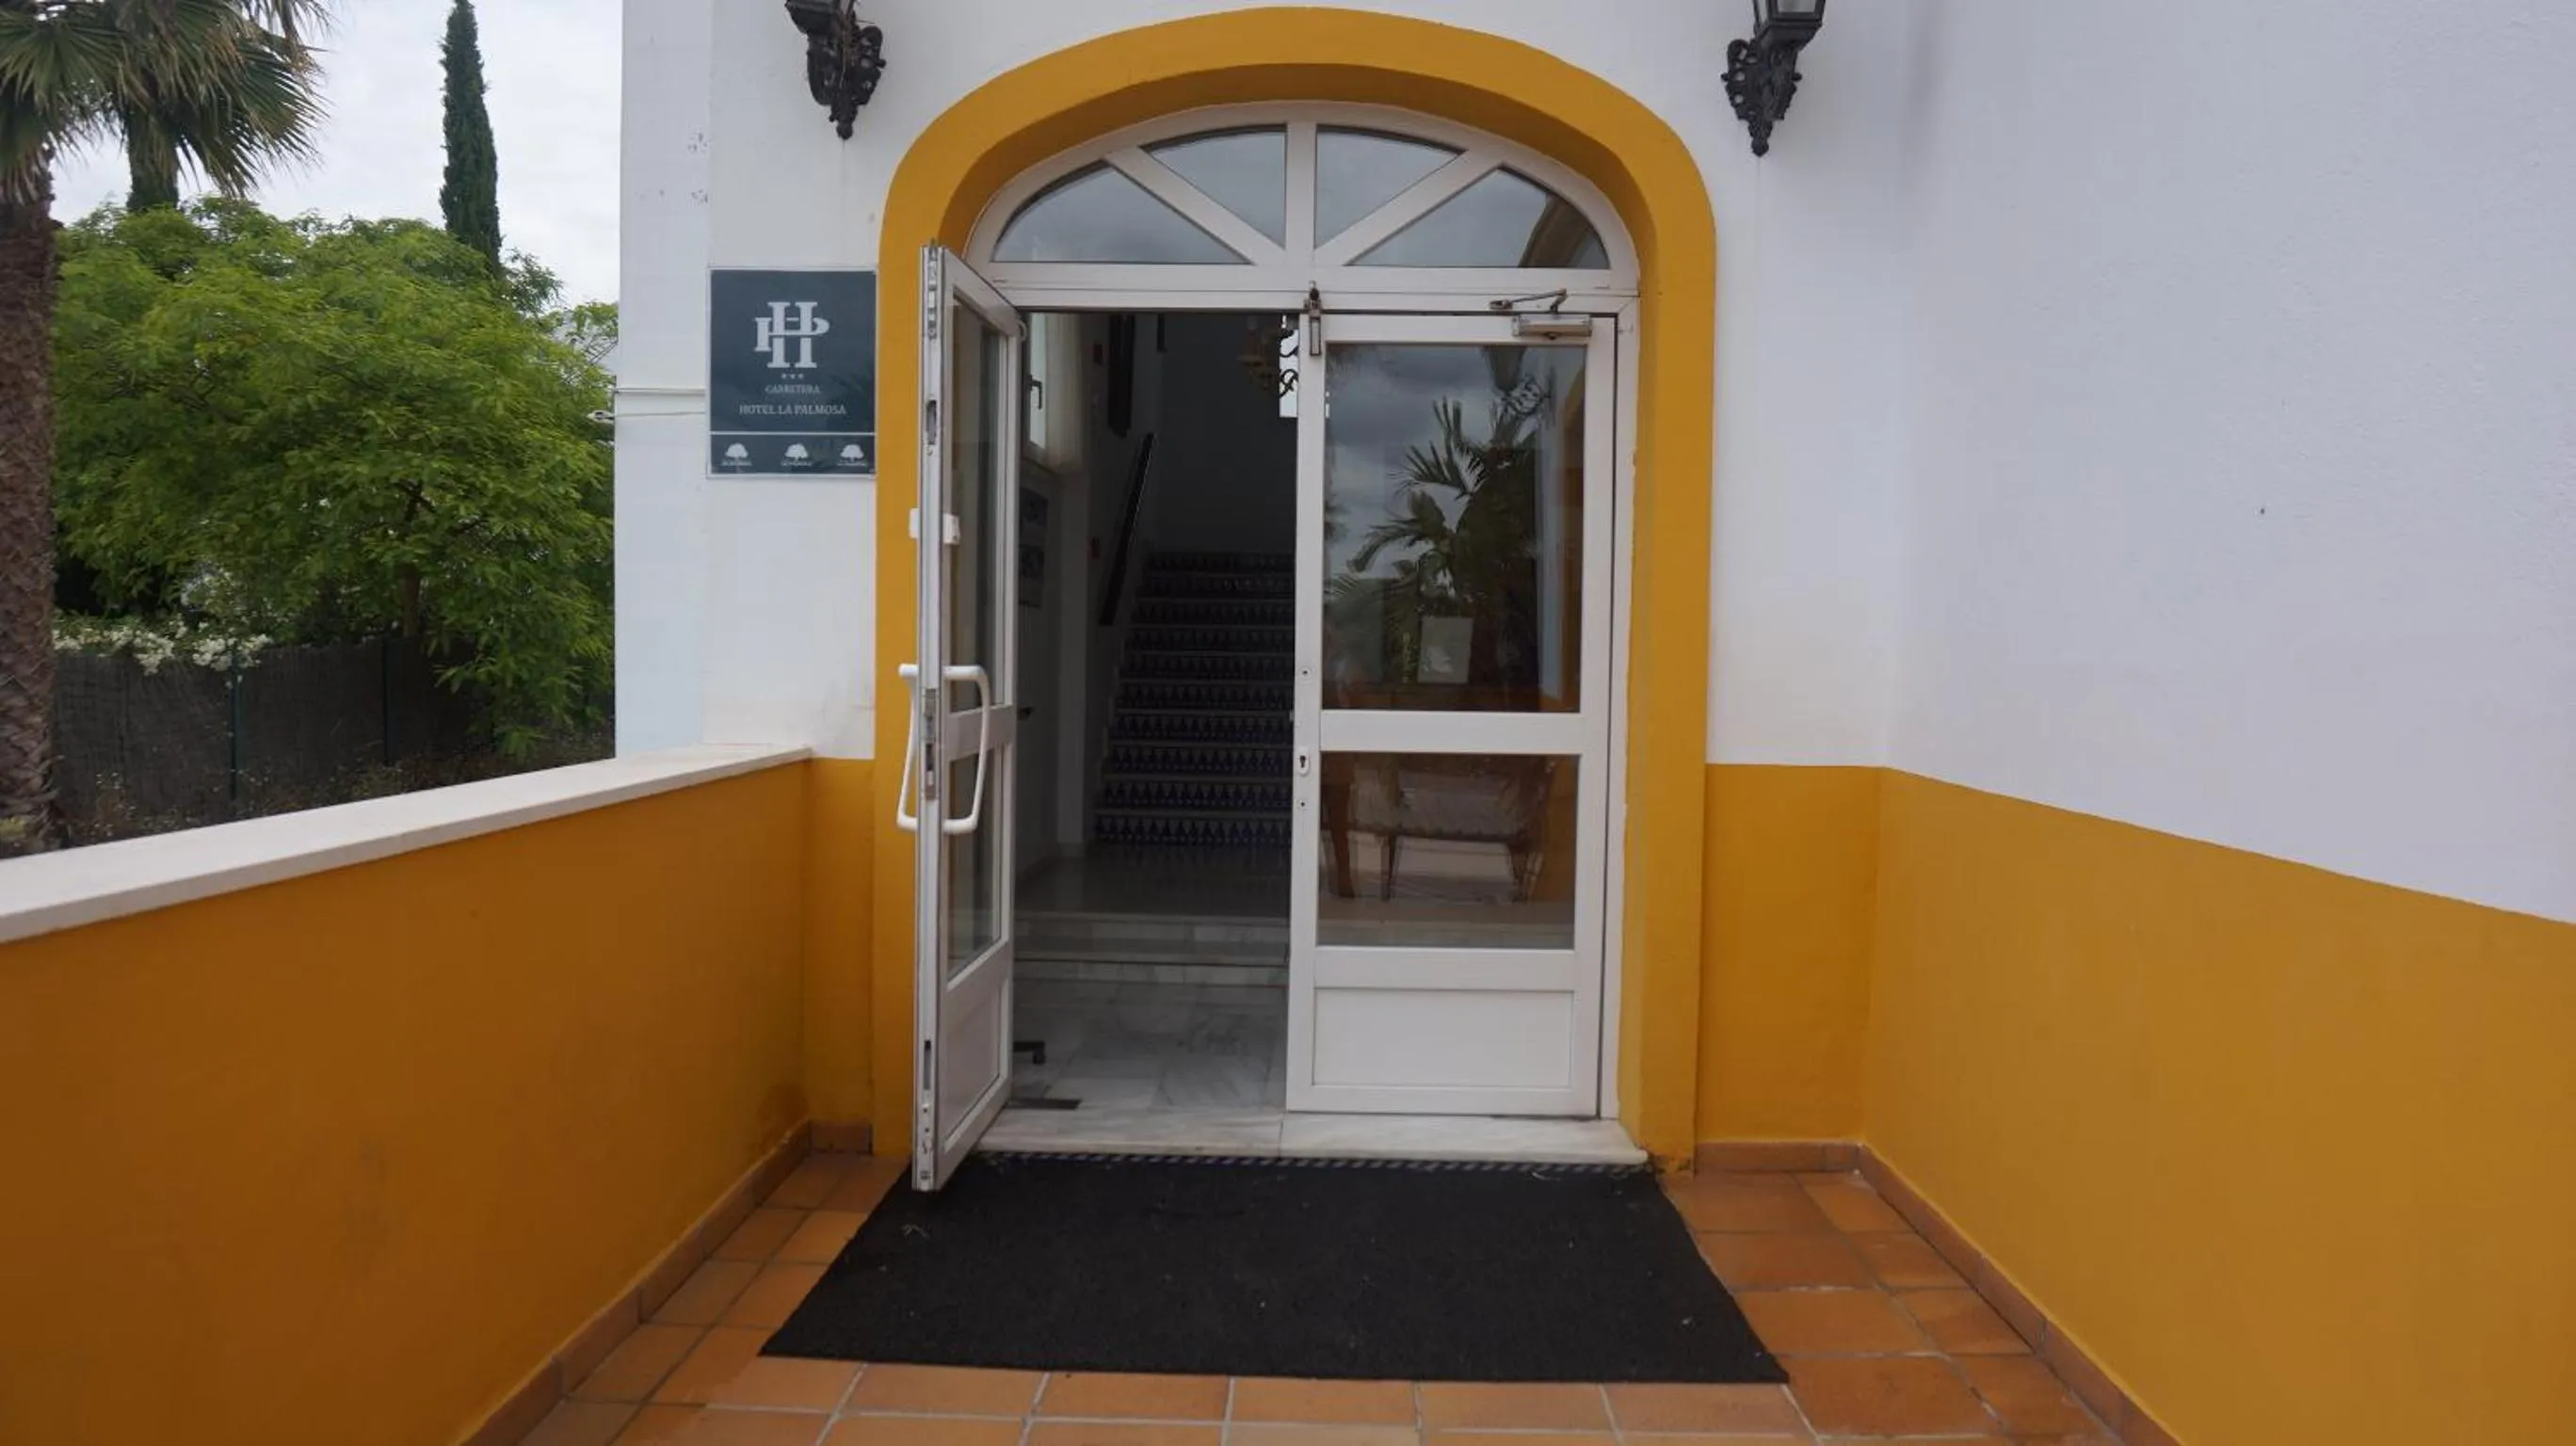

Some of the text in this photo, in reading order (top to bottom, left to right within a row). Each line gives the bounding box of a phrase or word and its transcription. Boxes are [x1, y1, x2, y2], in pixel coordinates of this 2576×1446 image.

[765, 384, 821, 394] CARRETERA
[739, 404, 846, 415] HOTEL LA PALMOSA
